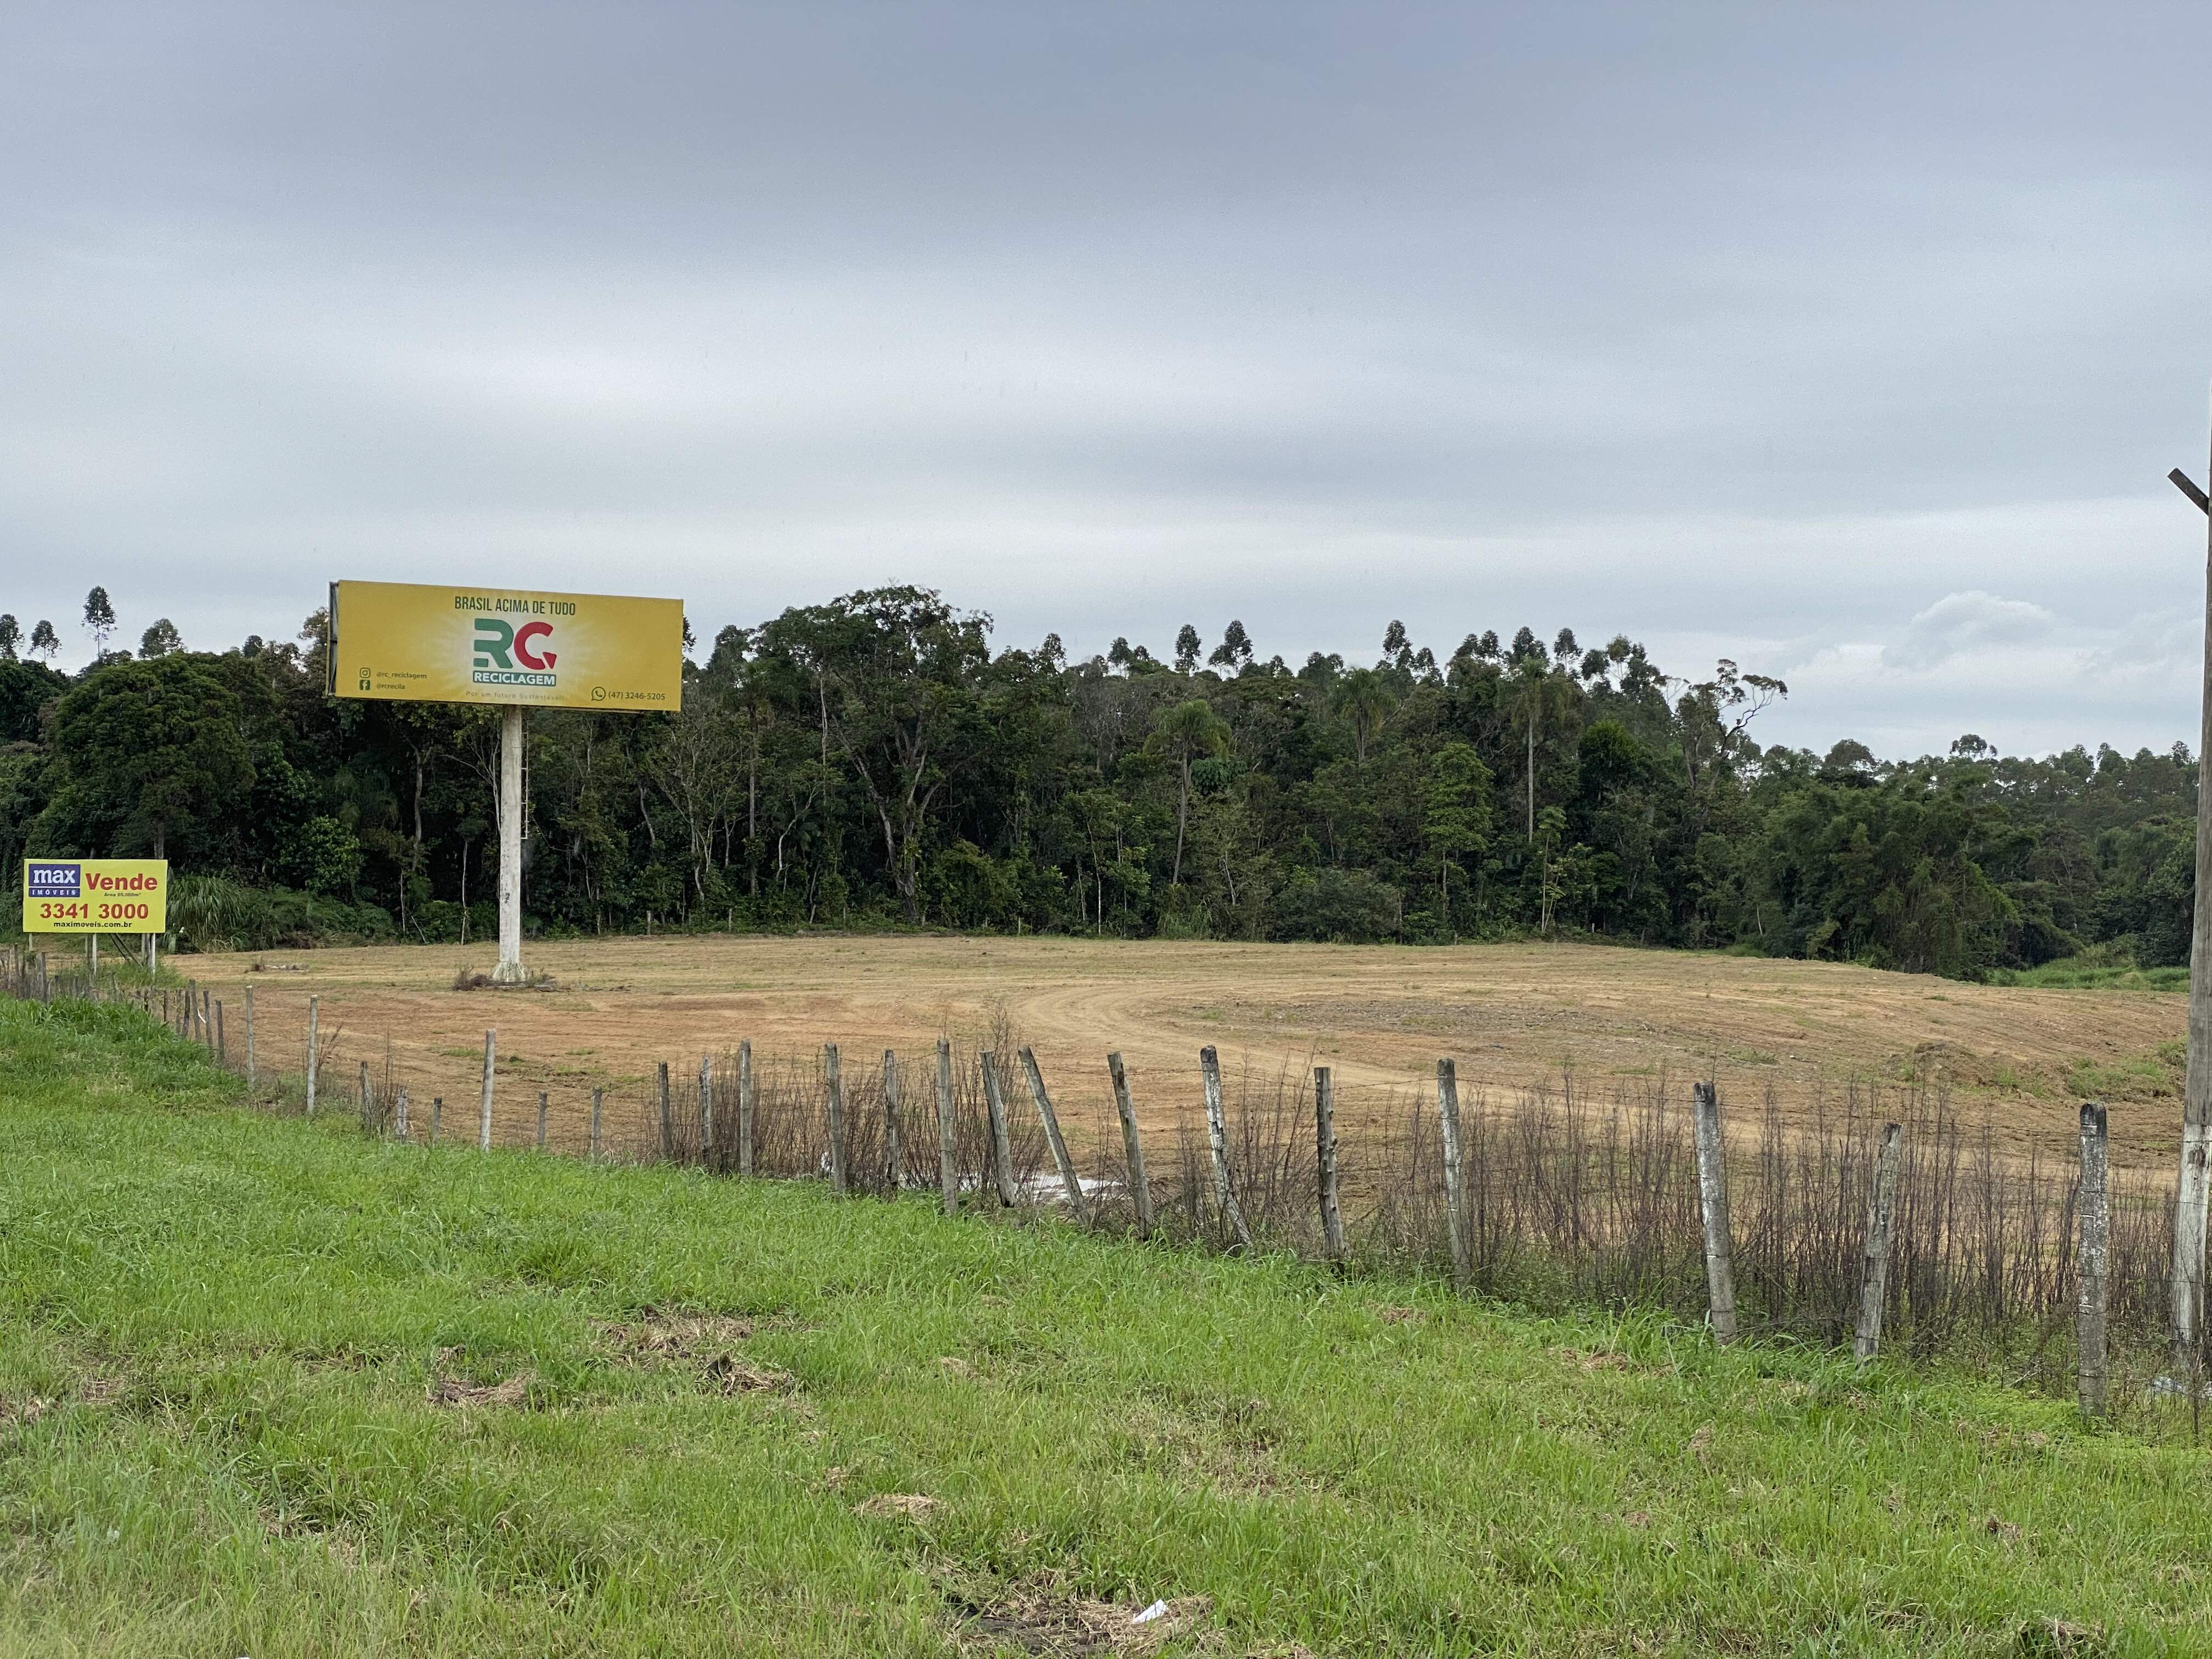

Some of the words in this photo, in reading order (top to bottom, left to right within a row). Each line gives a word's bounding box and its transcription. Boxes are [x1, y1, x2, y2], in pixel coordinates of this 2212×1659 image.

[455, 596, 492, 611] BRASIL
[495, 599, 529, 613] ACIMA
[533, 601, 545, 614] DE
[549, 602, 575, 616] TUDO
[376, 671, 427, 680] @rc_reciclagem
[474, 672, 555, 685] RECICLAGEM
[608, 691, 623, 699] (47)
[33, 870, 75, 884] max
[86, 873, 157, 890] Vende
[40, 903, 88, 919] 3341
[98, 904, 148, 919] 3000
